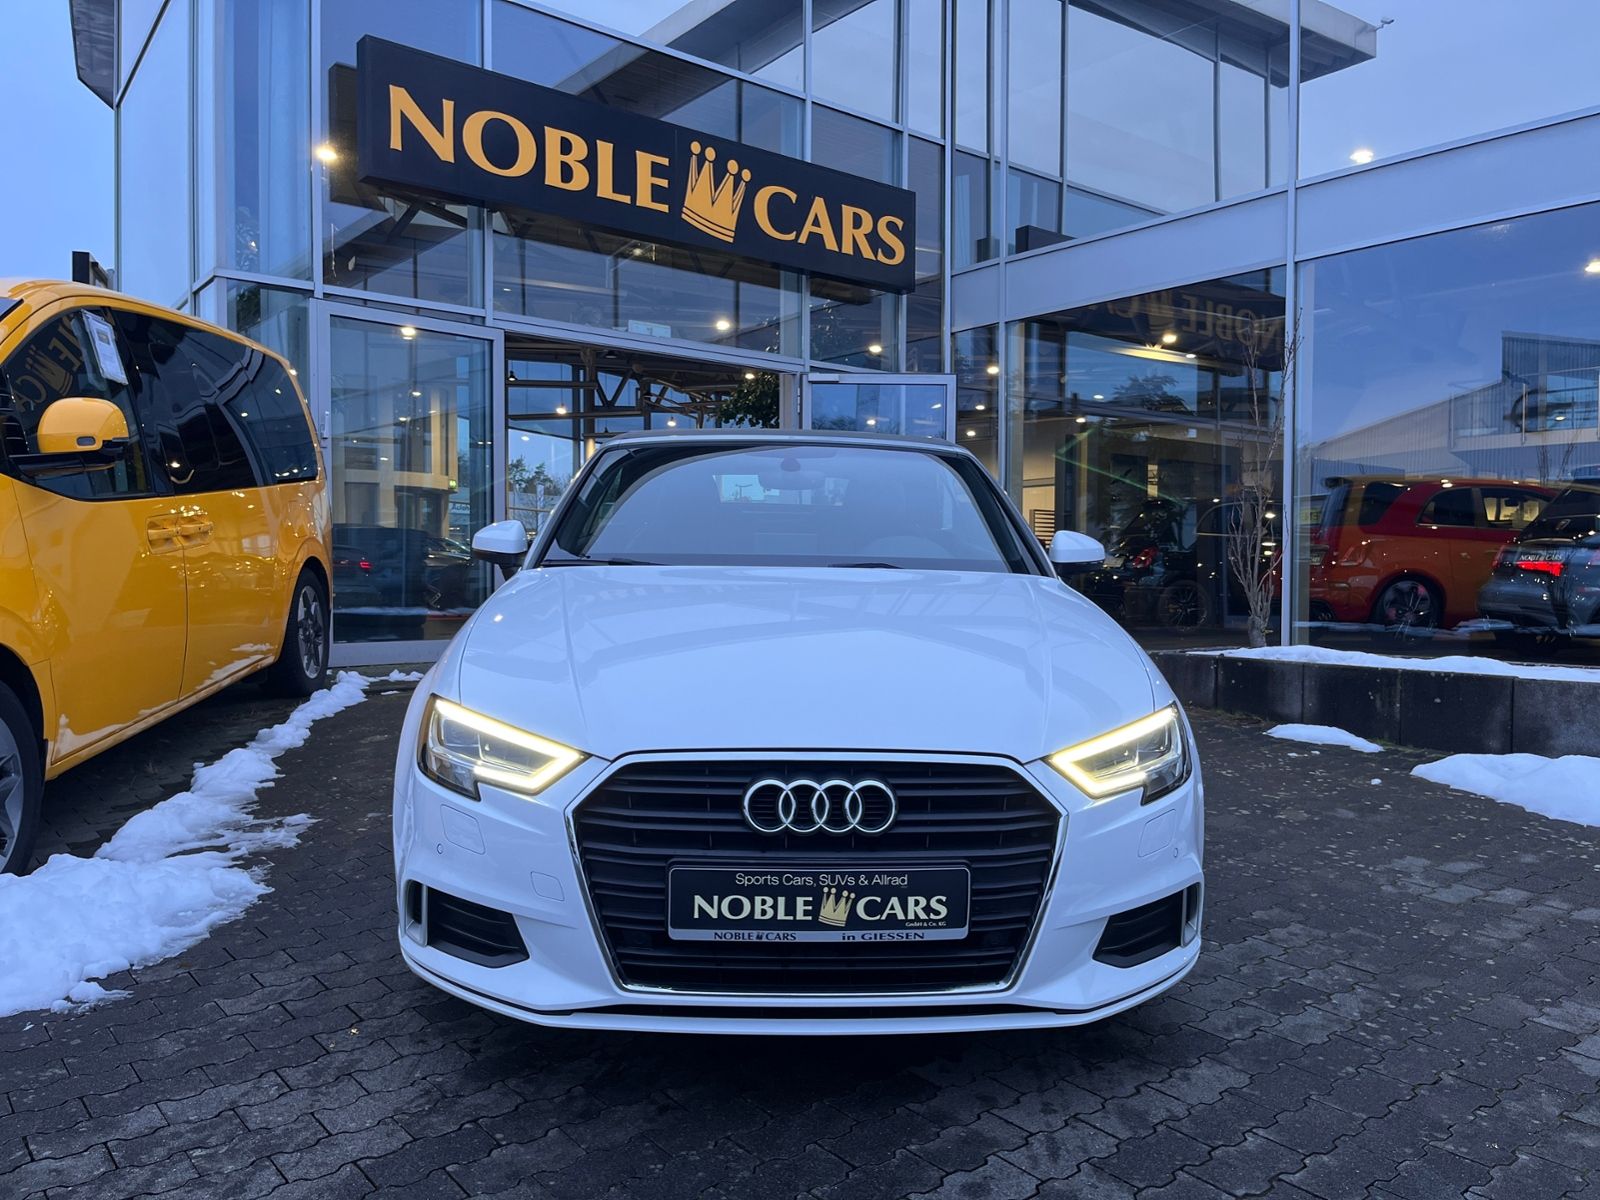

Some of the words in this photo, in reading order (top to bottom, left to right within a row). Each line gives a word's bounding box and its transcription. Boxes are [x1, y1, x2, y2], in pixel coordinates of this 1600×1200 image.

[388, 84, 670, 213] NOBLE
[753, 185, 906, 266] CARS
[735, 873, 780, 886] Sports
[782, 873, 817, 887] Cars,
[819, 874, 856, 886] SUVs
[858, 874, 869, 886] &
[871, 874, 909, 886] Allrad
[693, 894, 813, 920] NOBLE
[856, 895, 948, 920] CARS
[714, 931, 754, 941] NOBLE
[765, 932, 797, 941] CARS
[842, 932, 856, 941] in
[861, 932, 925, 941] GIESSEN
